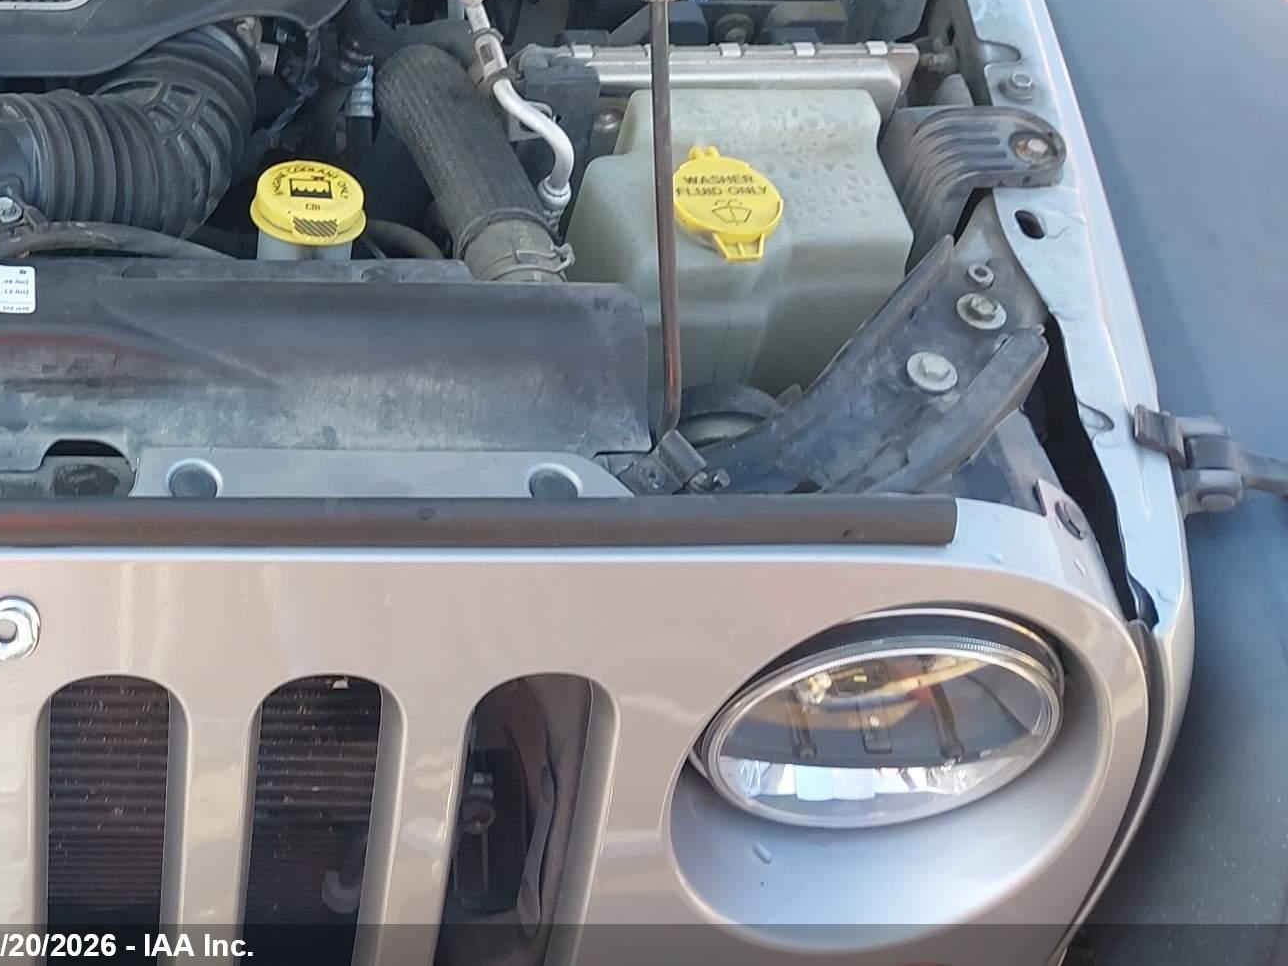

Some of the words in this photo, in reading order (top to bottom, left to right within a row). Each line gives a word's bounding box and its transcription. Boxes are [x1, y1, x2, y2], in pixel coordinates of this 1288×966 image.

[683, 174, 755, 185] WASHER
[676, 185, 723, 197] FLUID
[727, 185, 768, 196] ONLY
